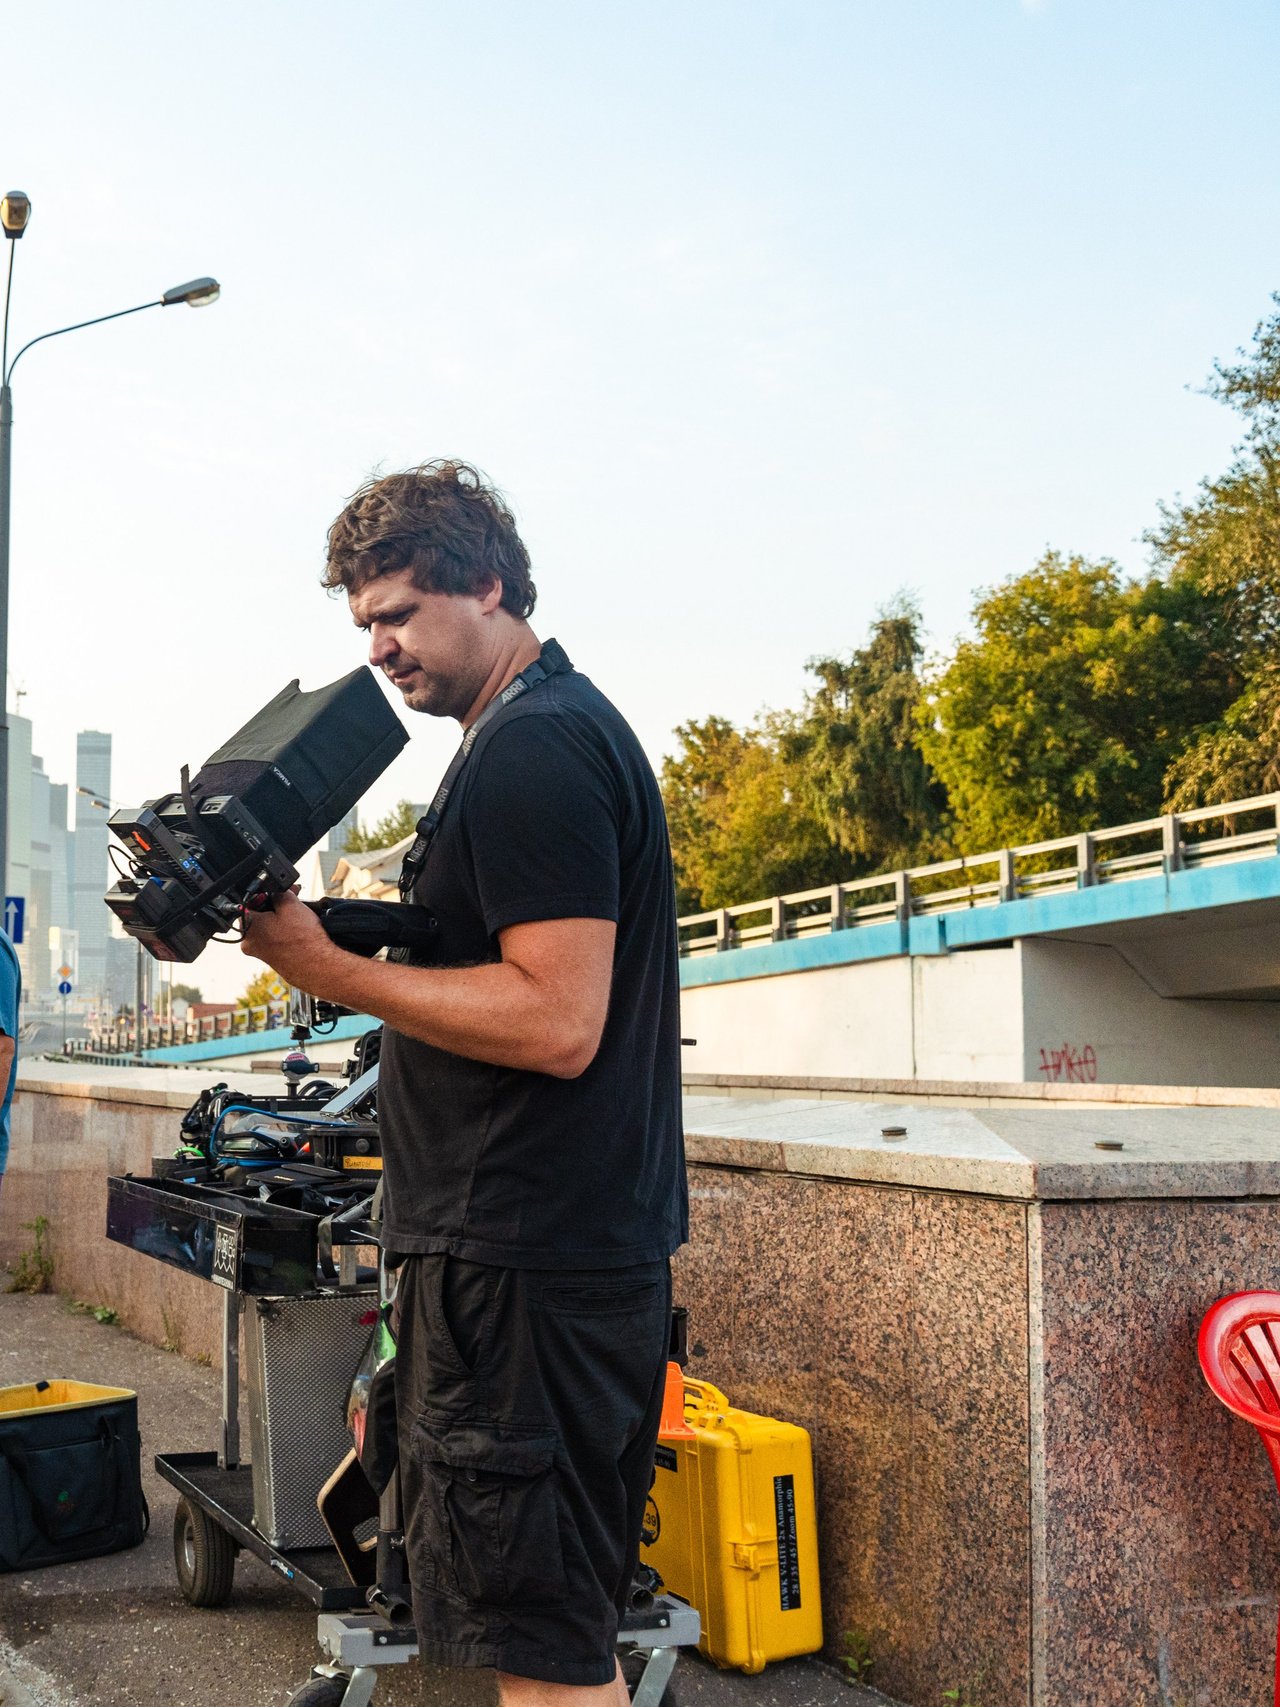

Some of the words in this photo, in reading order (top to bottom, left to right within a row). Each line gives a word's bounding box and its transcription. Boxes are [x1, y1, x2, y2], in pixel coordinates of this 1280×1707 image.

[501, 678, 525, 704] ARRI
[462, 729, 478, 757] ARRI
[433, 787, 449, 814] ARRI
[775, 1476, 785, 1527] Anamorphic
[786, 1488, 795, 1513] 45-90
[778, 1529, 785, 1541] 2x
[789, 1515, 797, 1540] Zoom
[778, 1541, 787, 1576] V-LITE
[781, 1578, 789, 1610] HAWK
